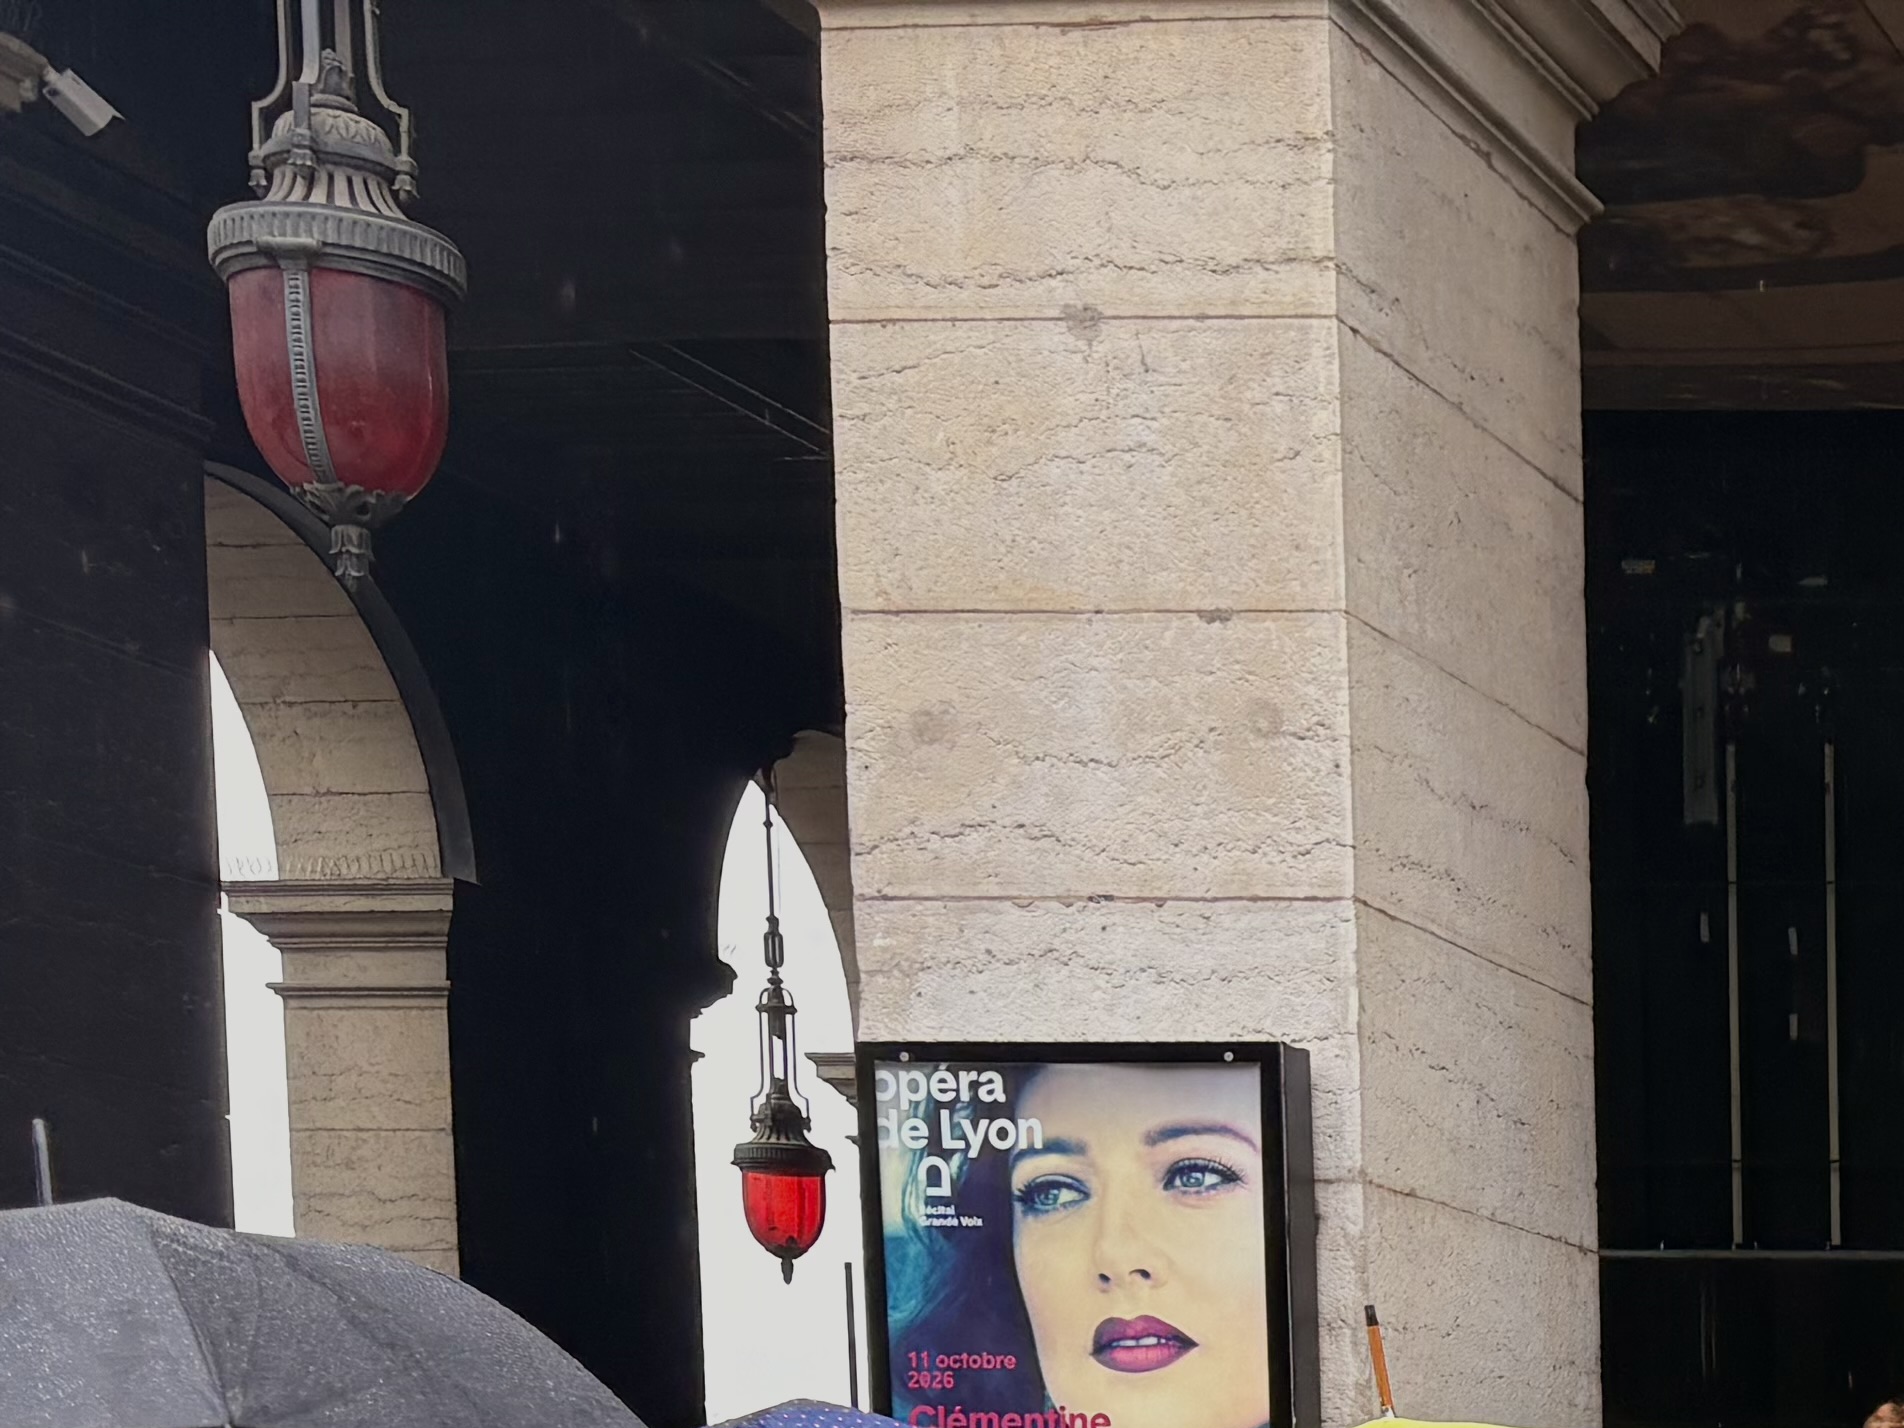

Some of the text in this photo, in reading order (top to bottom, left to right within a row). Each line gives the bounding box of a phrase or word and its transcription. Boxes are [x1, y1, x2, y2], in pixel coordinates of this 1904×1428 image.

[876, 1064, 1006, 1112] opéra
[877, 1108, 1043, 1159] de Lyon
[907, 1351, 1017, 1370] 11 octobre
[907, 1371, 956, 1389] 2026
